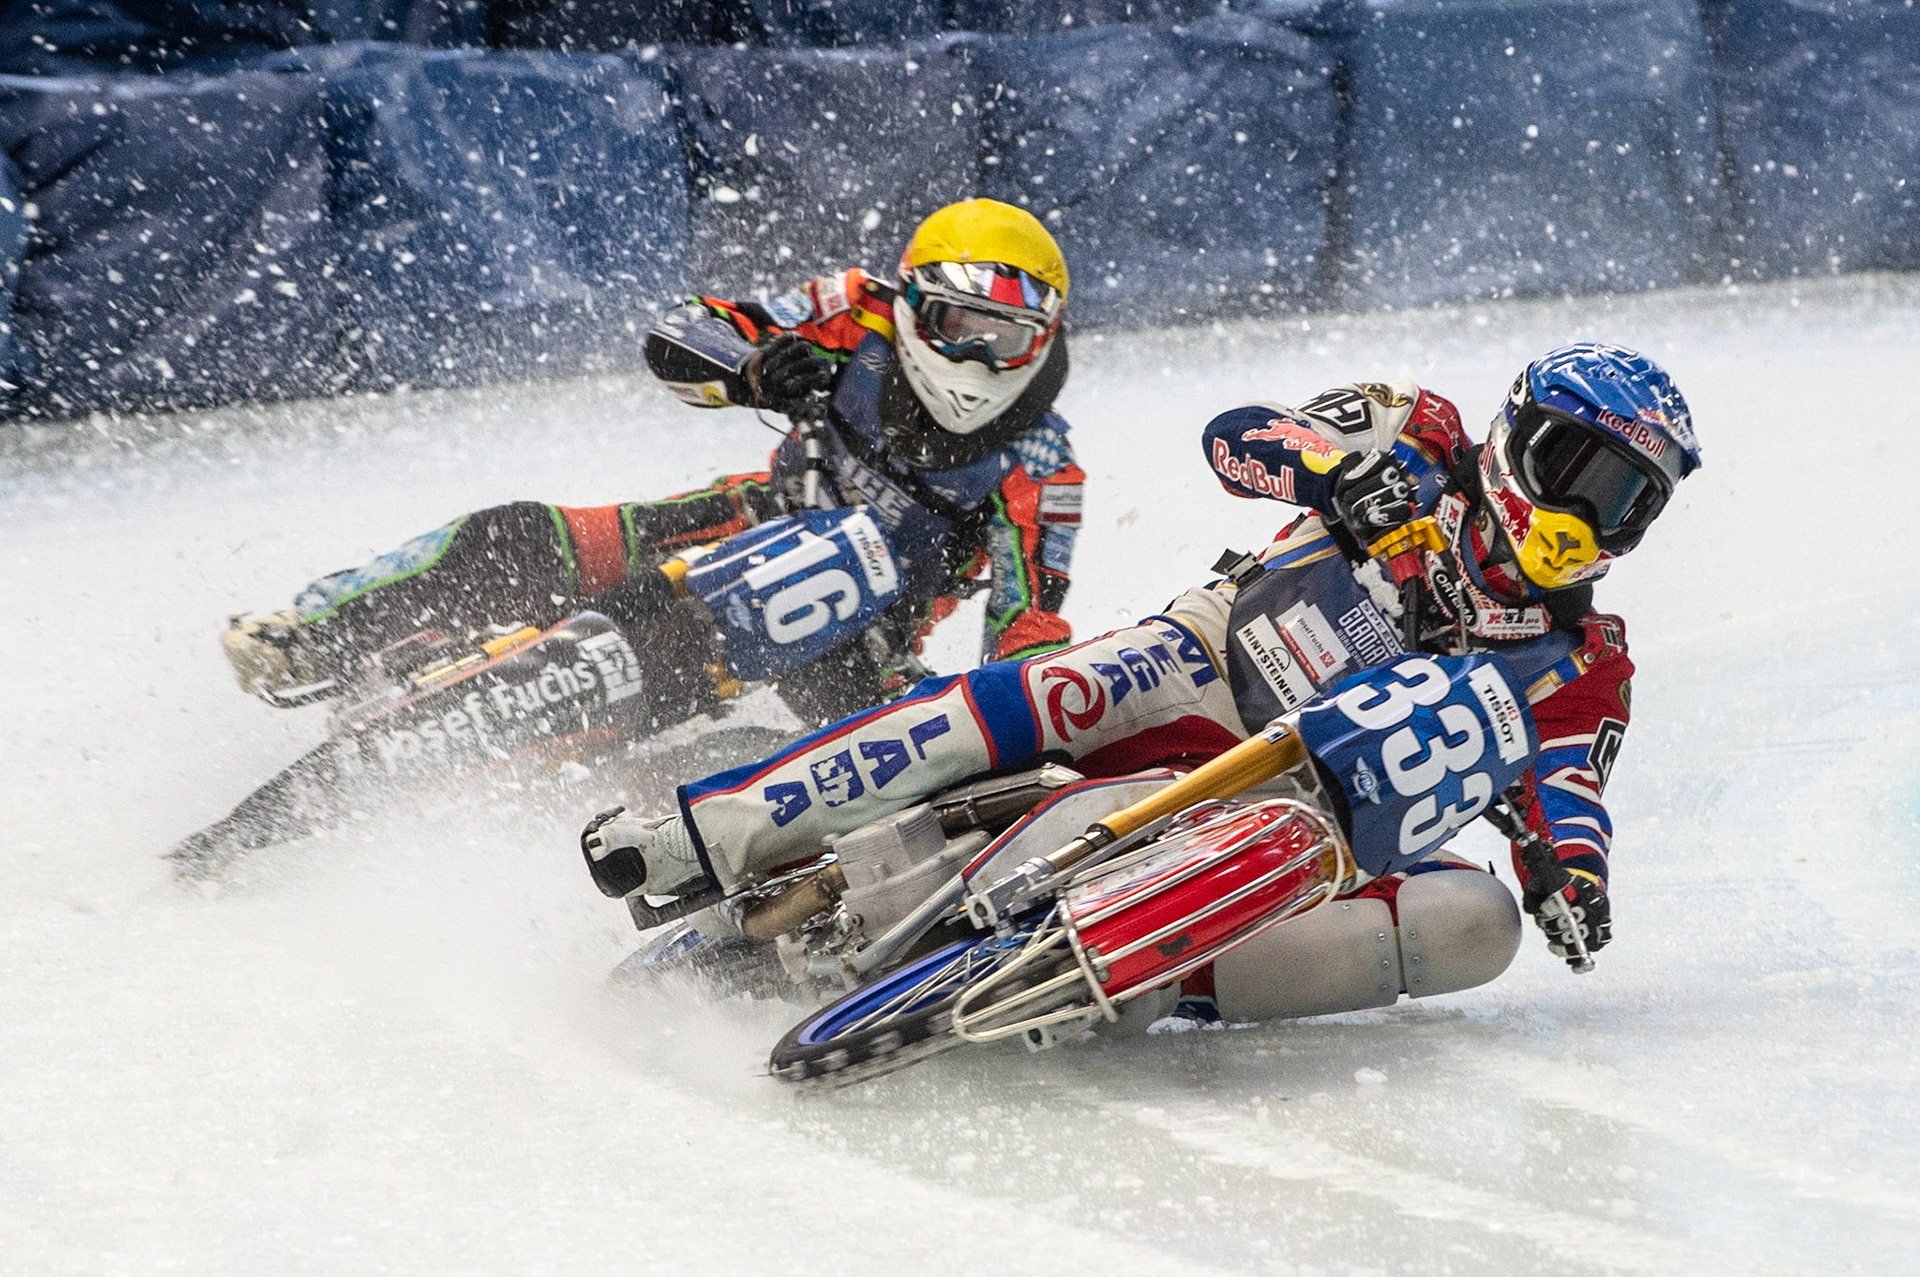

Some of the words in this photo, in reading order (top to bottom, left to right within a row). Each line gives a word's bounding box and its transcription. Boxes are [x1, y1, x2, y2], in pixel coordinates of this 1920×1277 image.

[1634, 428, 1667, 459] Bull
[1250, 459, 1297, 503] Bull
[743, 530, 861, 644] 16
[1243, 628, 1297, 705] HINTSTEINER
[1270, 650, 1285, 671] MAN
[1484, 684, 1514, 744] TISSOT
[1337, 658, 1493, 855] 333
